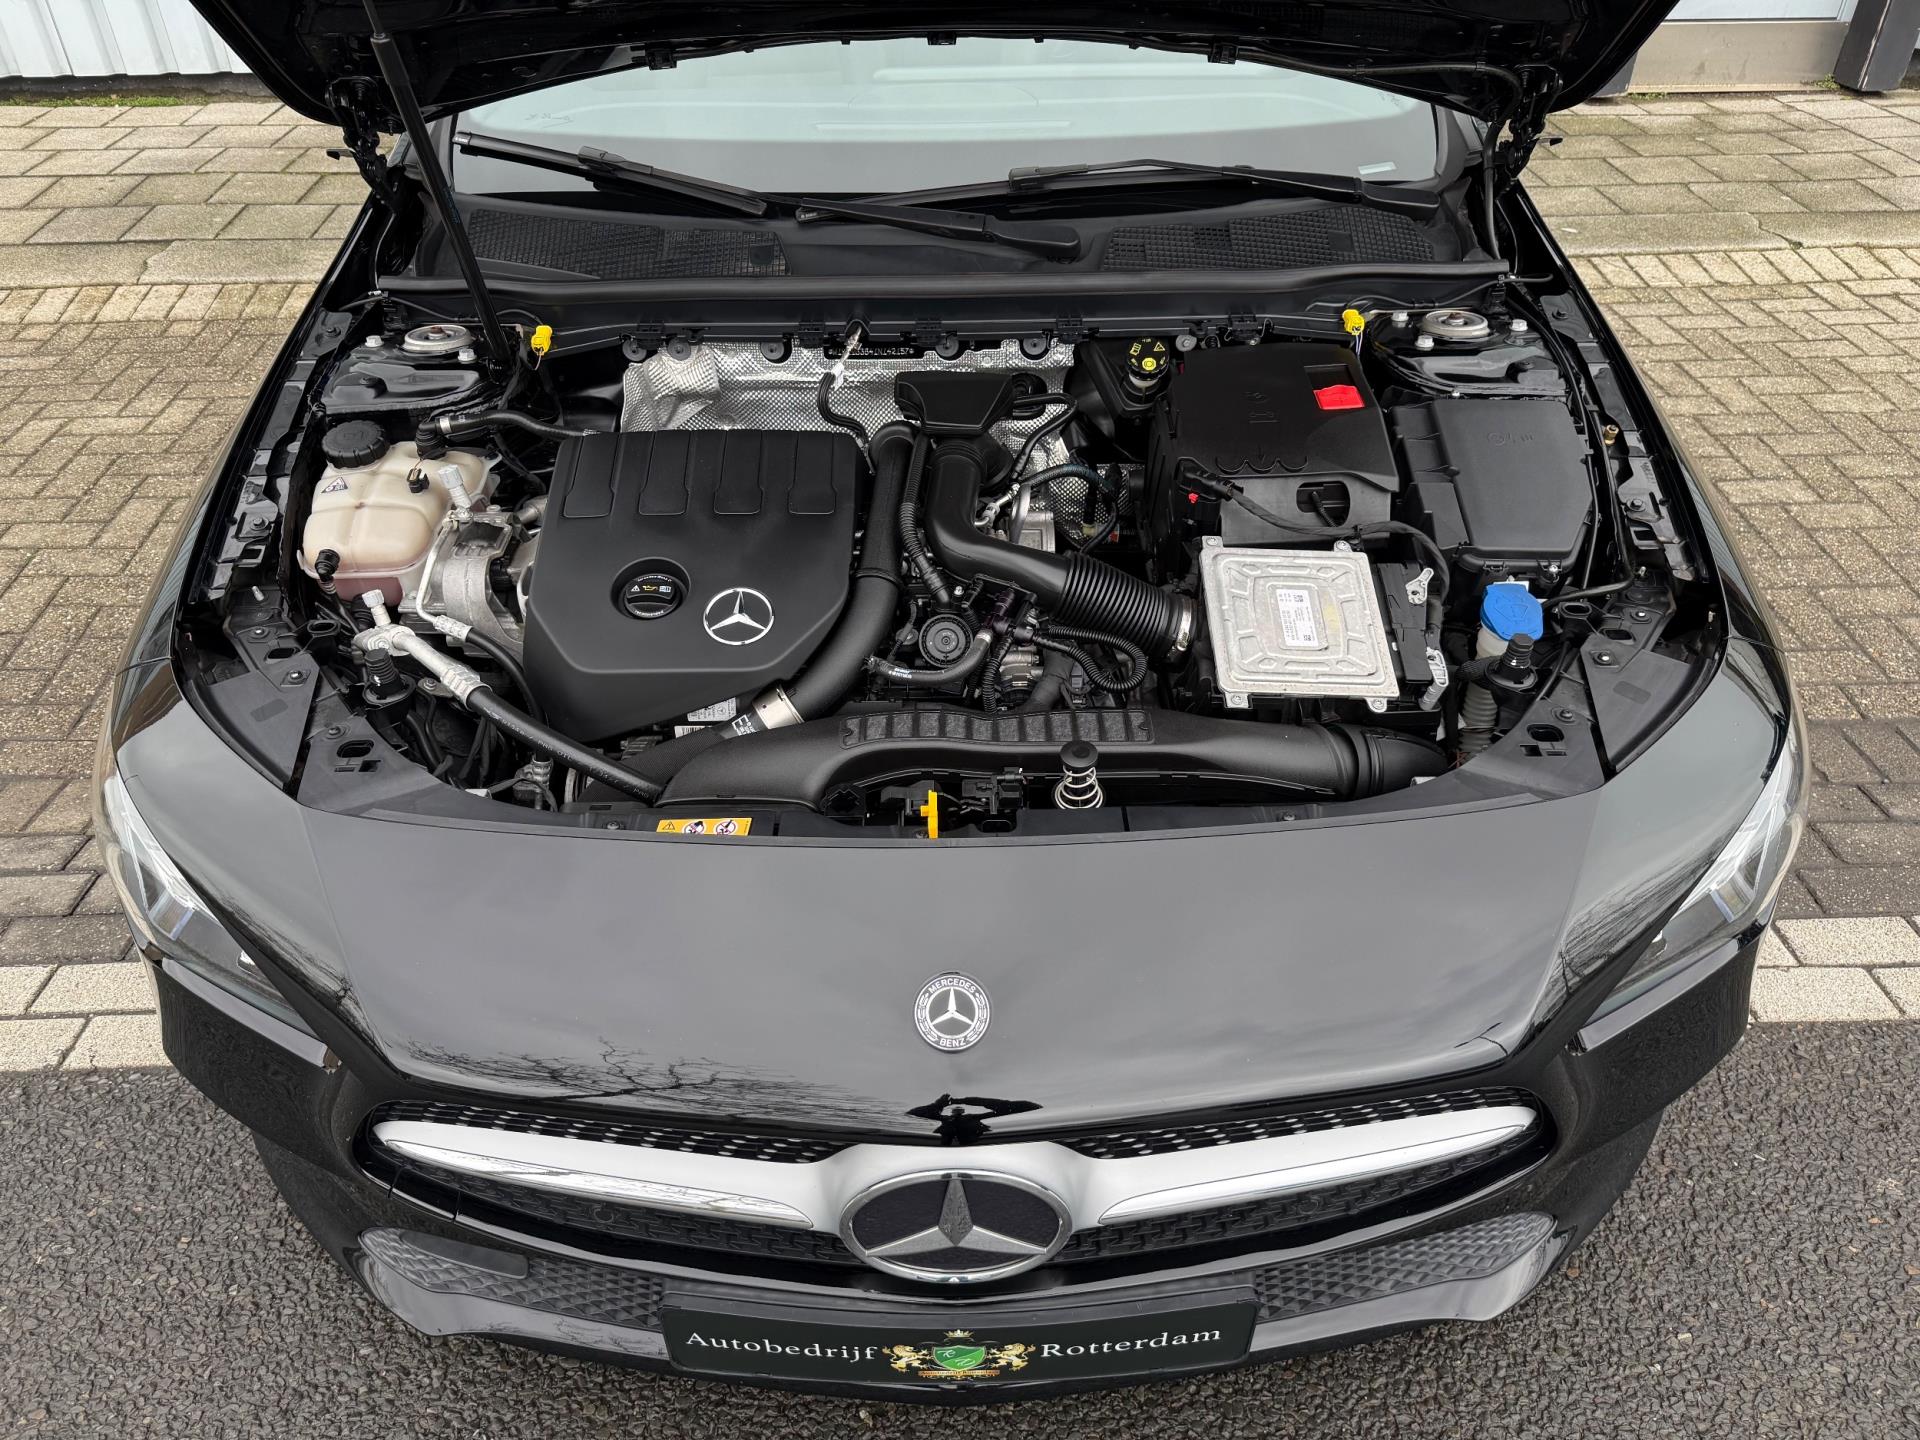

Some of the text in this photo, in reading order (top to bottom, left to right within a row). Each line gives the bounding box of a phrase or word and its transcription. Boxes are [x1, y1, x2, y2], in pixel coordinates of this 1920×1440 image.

[928, 978, 976, 993] MERCEDES
[939, 1038, 967, 1047] BENZ
[686, 1329, 1222, 1363] Autobedrijf Rotterdam
